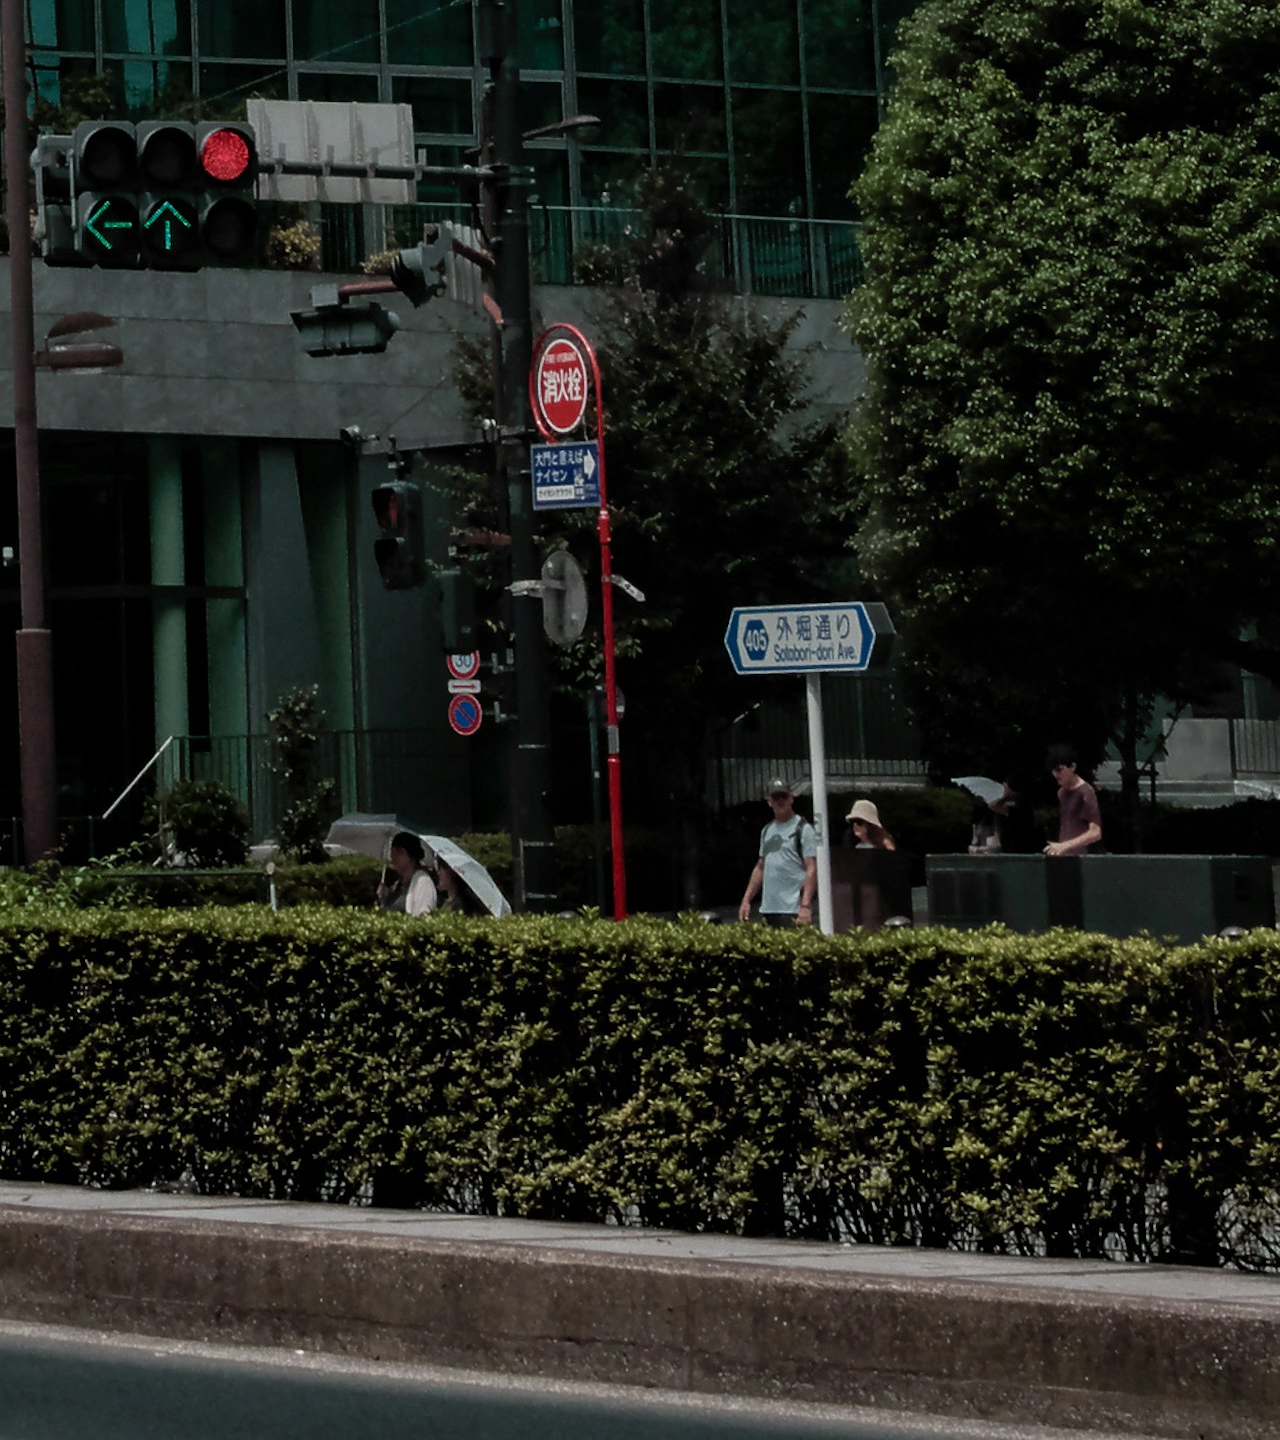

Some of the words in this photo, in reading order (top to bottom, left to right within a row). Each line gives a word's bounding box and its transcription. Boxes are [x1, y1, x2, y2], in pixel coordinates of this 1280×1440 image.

[542, 367, 583, 404] 消火栓
[534, 448, 584, 467] 大門と言えば
[535, 468, 568, 484] ナイセン
[775, 613, 851, 641] 外堀通り
[745, 628, 767, 652] 405
[773, 642, 835, 663] Sotobori-dori
[837, 642, 858, 660] Ave.
